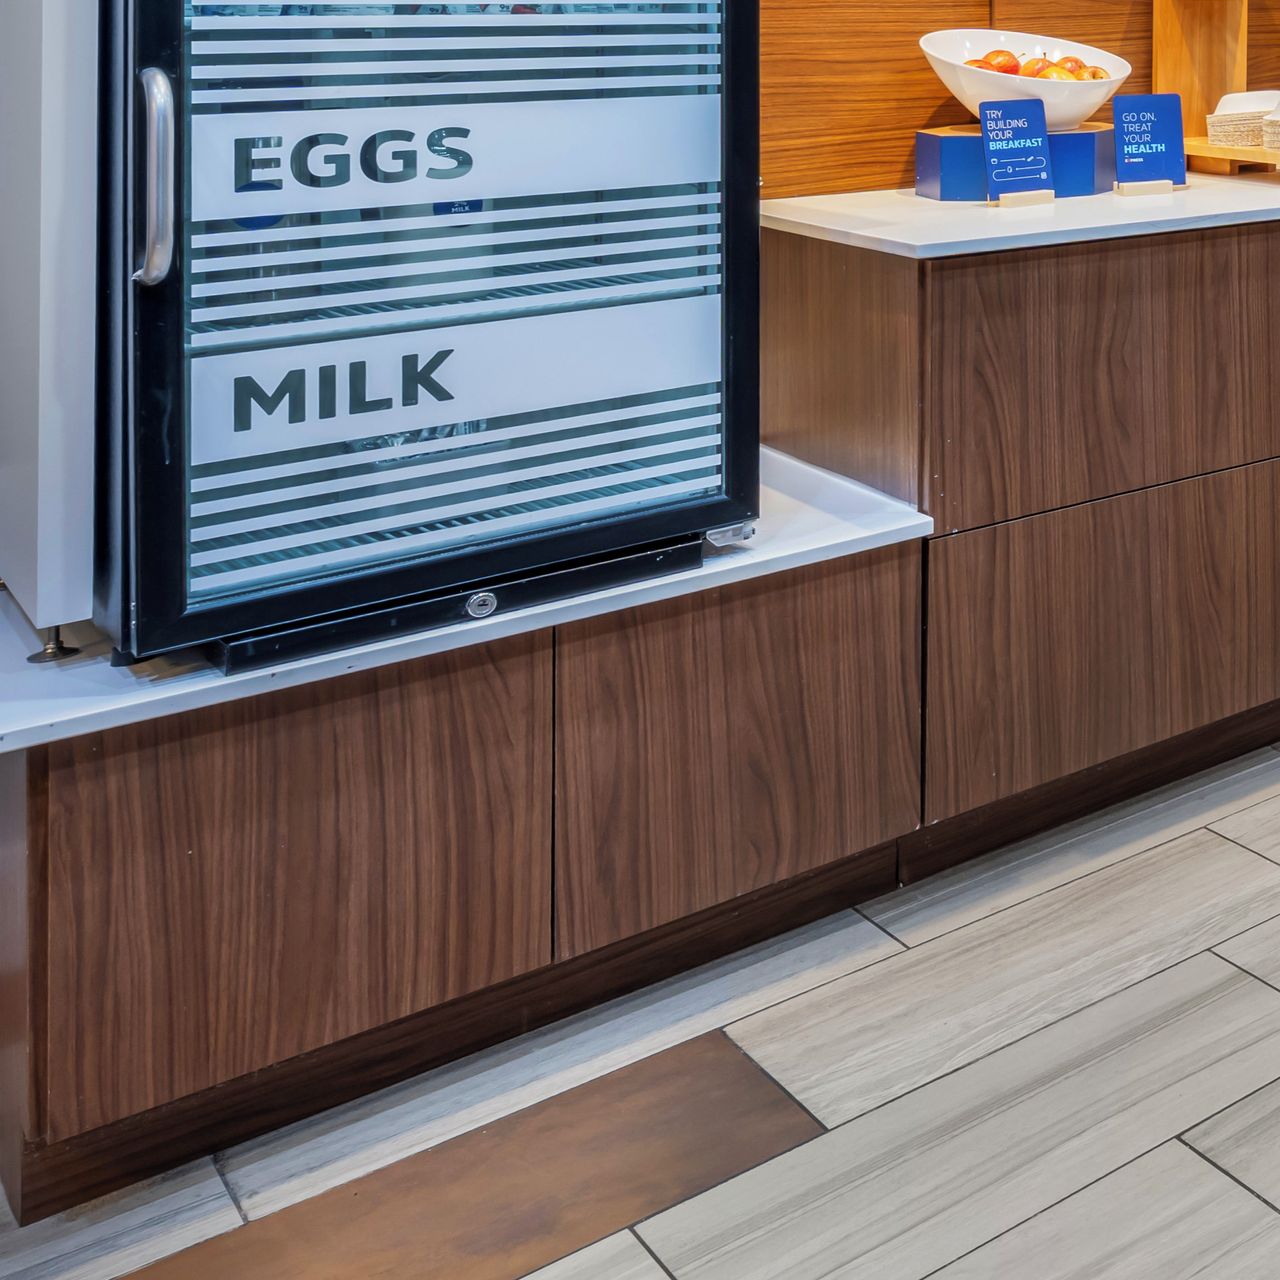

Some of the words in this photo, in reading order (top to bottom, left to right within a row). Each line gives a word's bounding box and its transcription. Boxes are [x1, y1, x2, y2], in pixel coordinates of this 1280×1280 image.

[985, 110, 1003, 119] TRY
[1122, 112, 1138, 122] GO
[1139, 112, 1157, 121] ON.
[987, 118, 1028, 130] BUILDING
[1123, 122, 1152, 132] TREAT
[988, 129, 1013, 140] YOUR
[1123, 133, 1151, 143] YOUR
[989, 137, 1043, 151] BREAKFAST
[1123, 143, 1166, 154] HEALTH
[233, 126, 474, 193] EGGS
[451, 205, 471, 213] MILK
[233, 349, 455, 433] MILK
